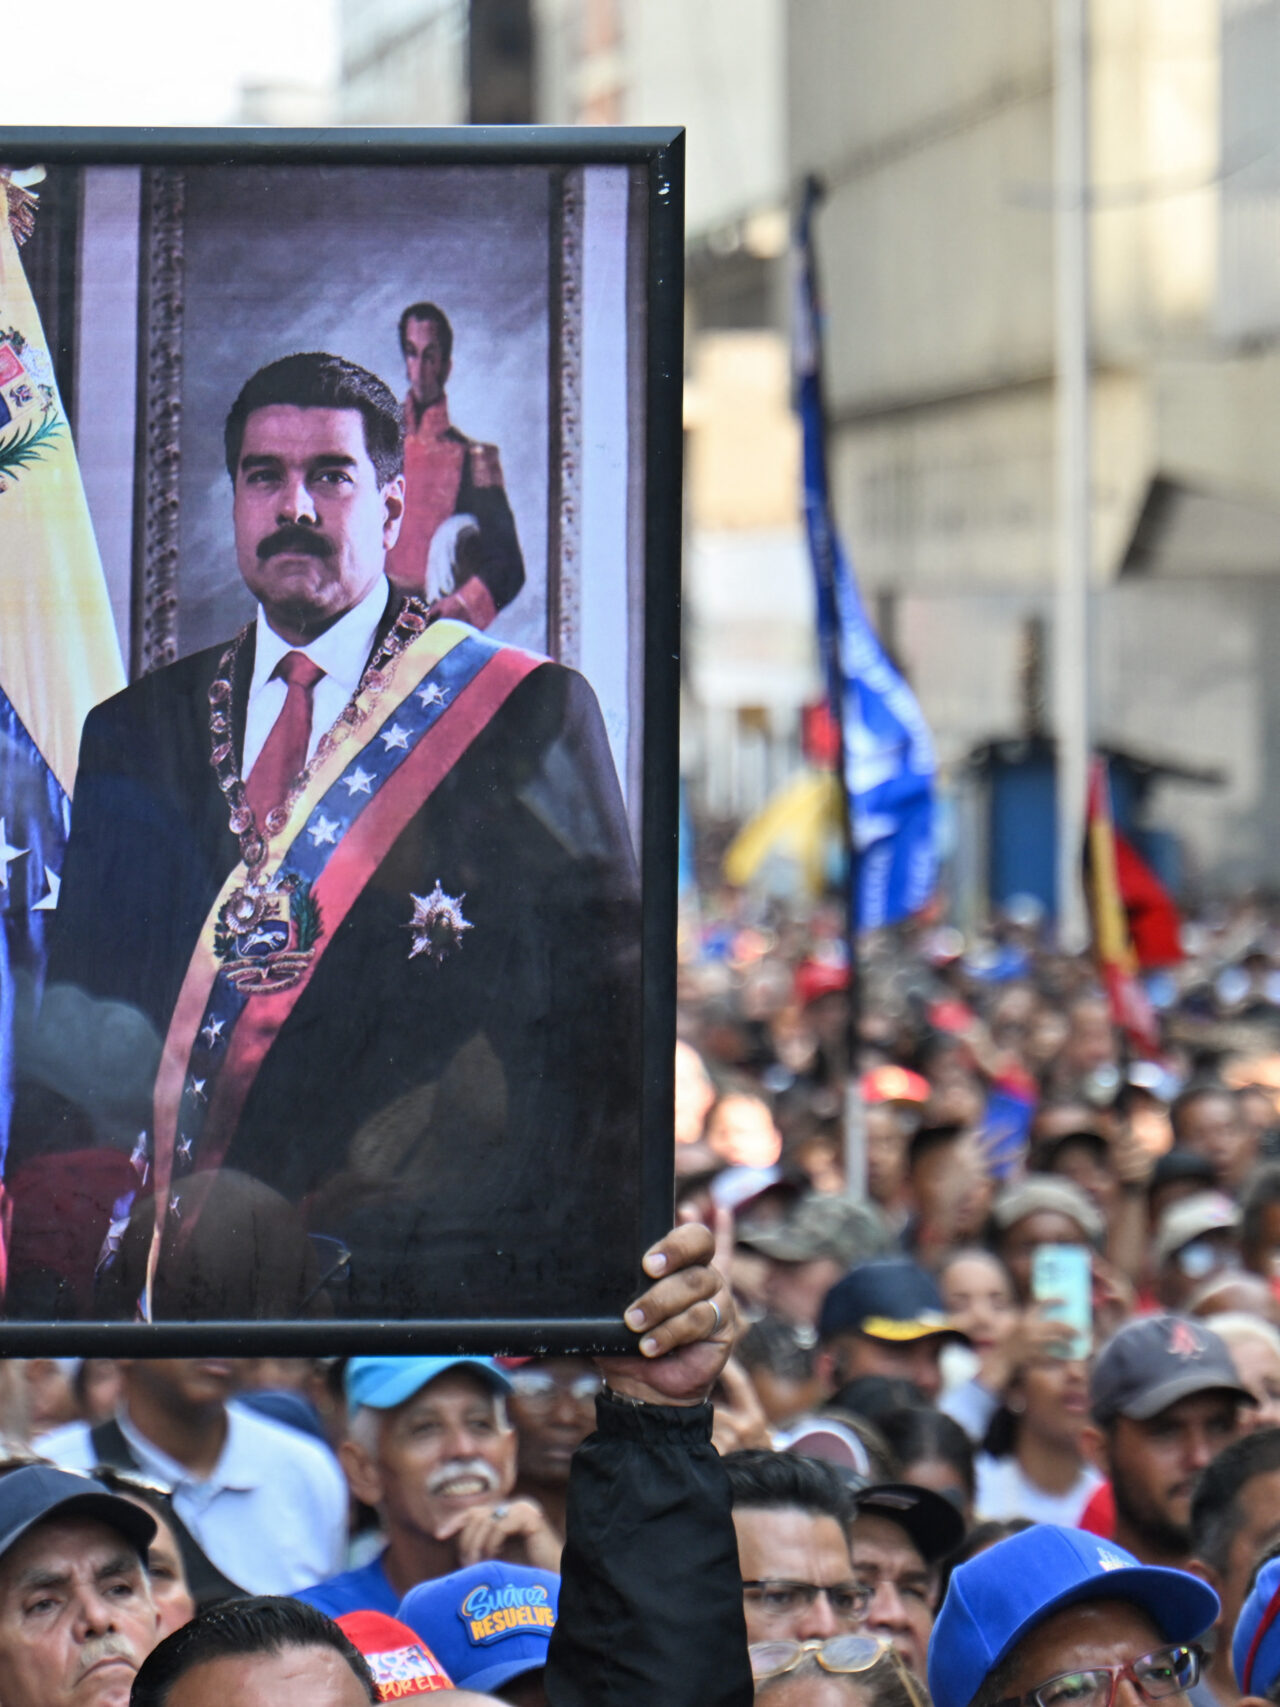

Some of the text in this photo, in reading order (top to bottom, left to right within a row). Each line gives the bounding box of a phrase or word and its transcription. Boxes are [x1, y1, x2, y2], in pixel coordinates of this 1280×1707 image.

[470, 1606, 556, 1641] RESUELVE
[378, 1674, 441, 1702] POR EL
